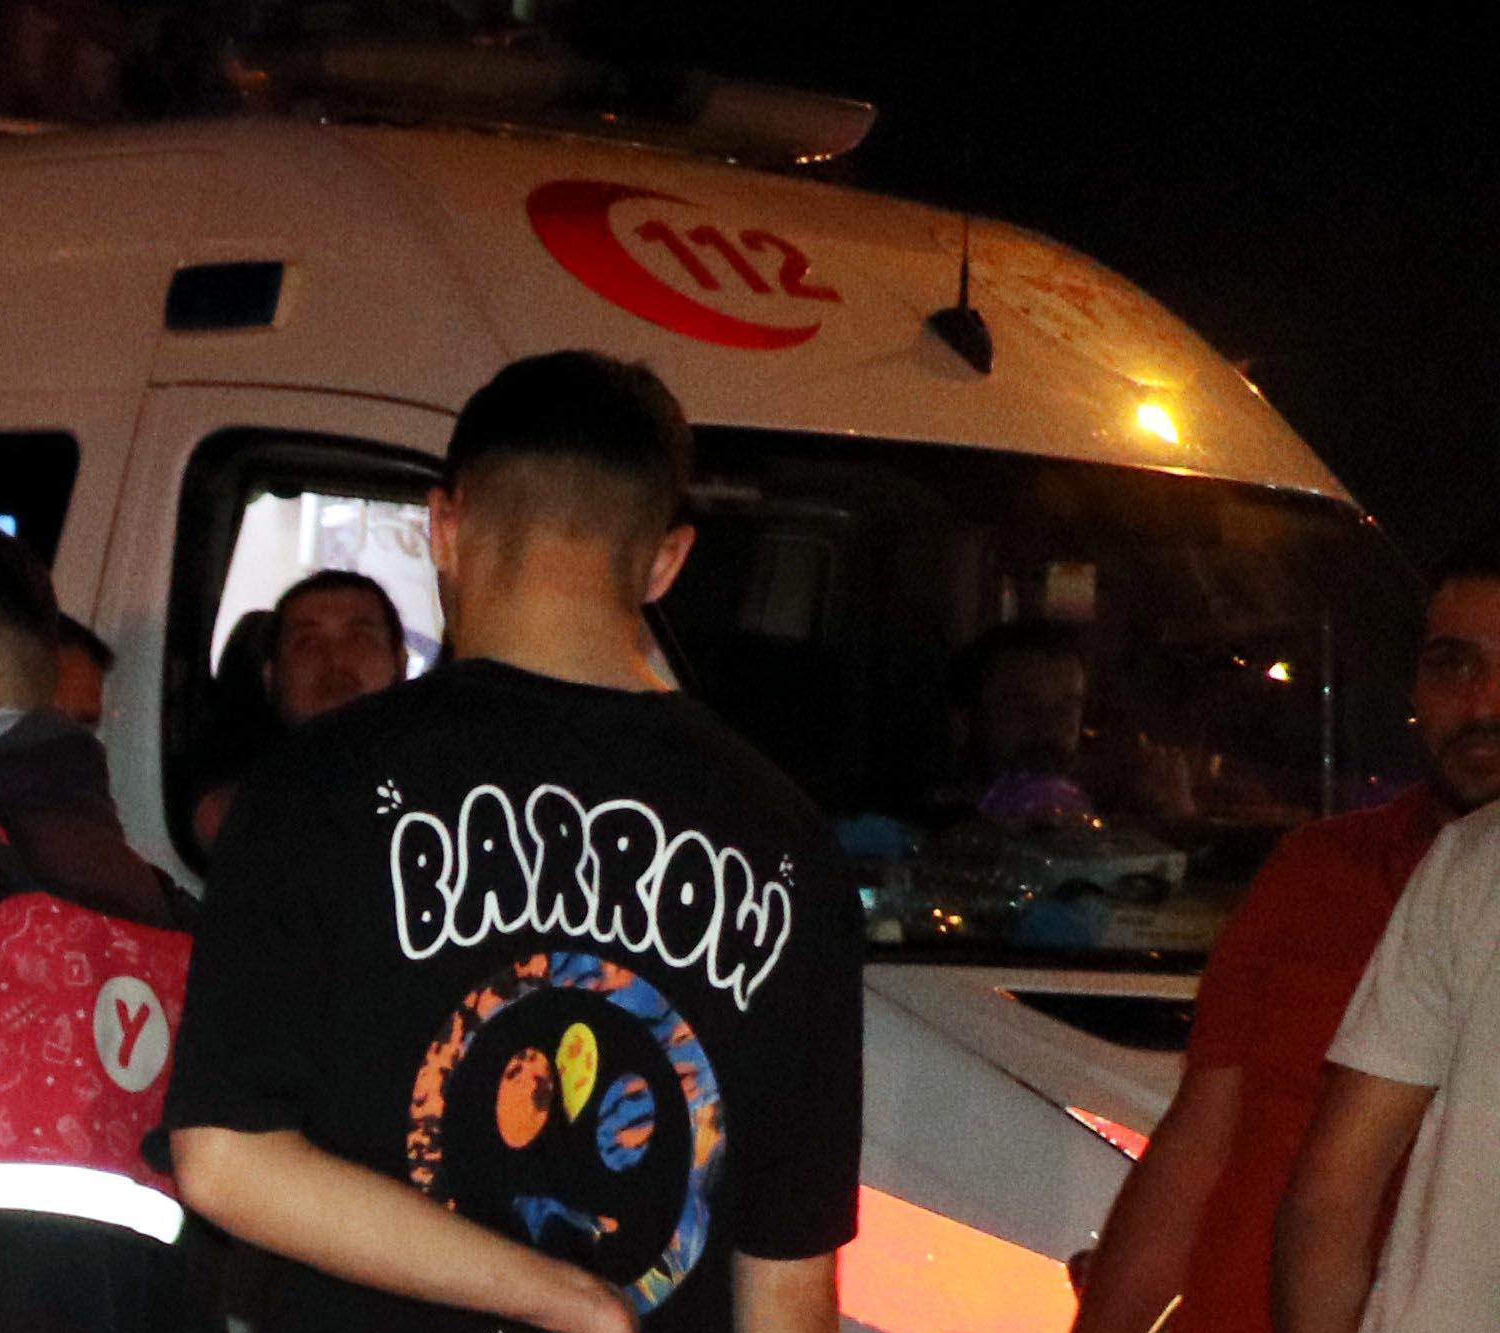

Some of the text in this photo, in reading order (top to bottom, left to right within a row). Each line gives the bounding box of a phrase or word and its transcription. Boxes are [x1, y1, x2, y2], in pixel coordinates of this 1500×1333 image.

[632, 218, 842, 303] 112
[390, 784, 792, 1012] BARROW
[115, 998, 152, 1069] Y
